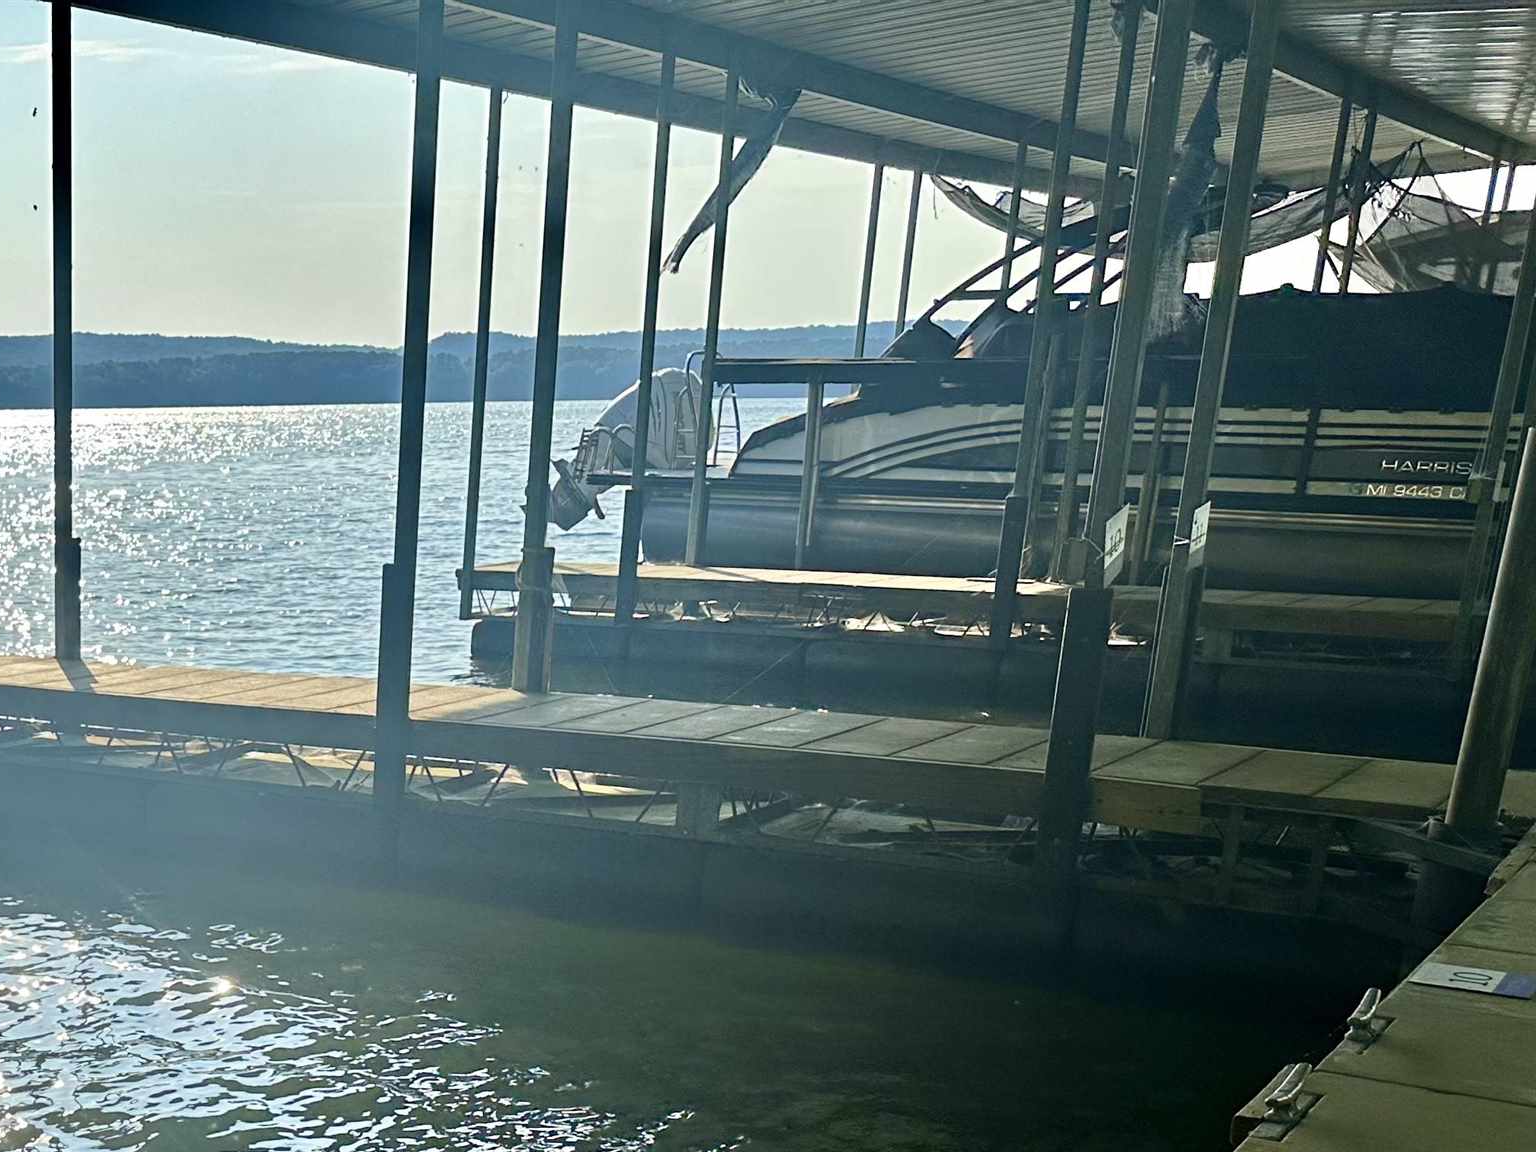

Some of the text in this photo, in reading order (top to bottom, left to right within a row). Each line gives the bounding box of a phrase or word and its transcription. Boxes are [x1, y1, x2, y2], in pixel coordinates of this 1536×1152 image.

[1380, 460, 1473, 475] HARRIS
[1366, 484, 1387, 496] MI
[1392, 485, 1443, 498] 9443
[1448, 971, 1493, 986] 10
